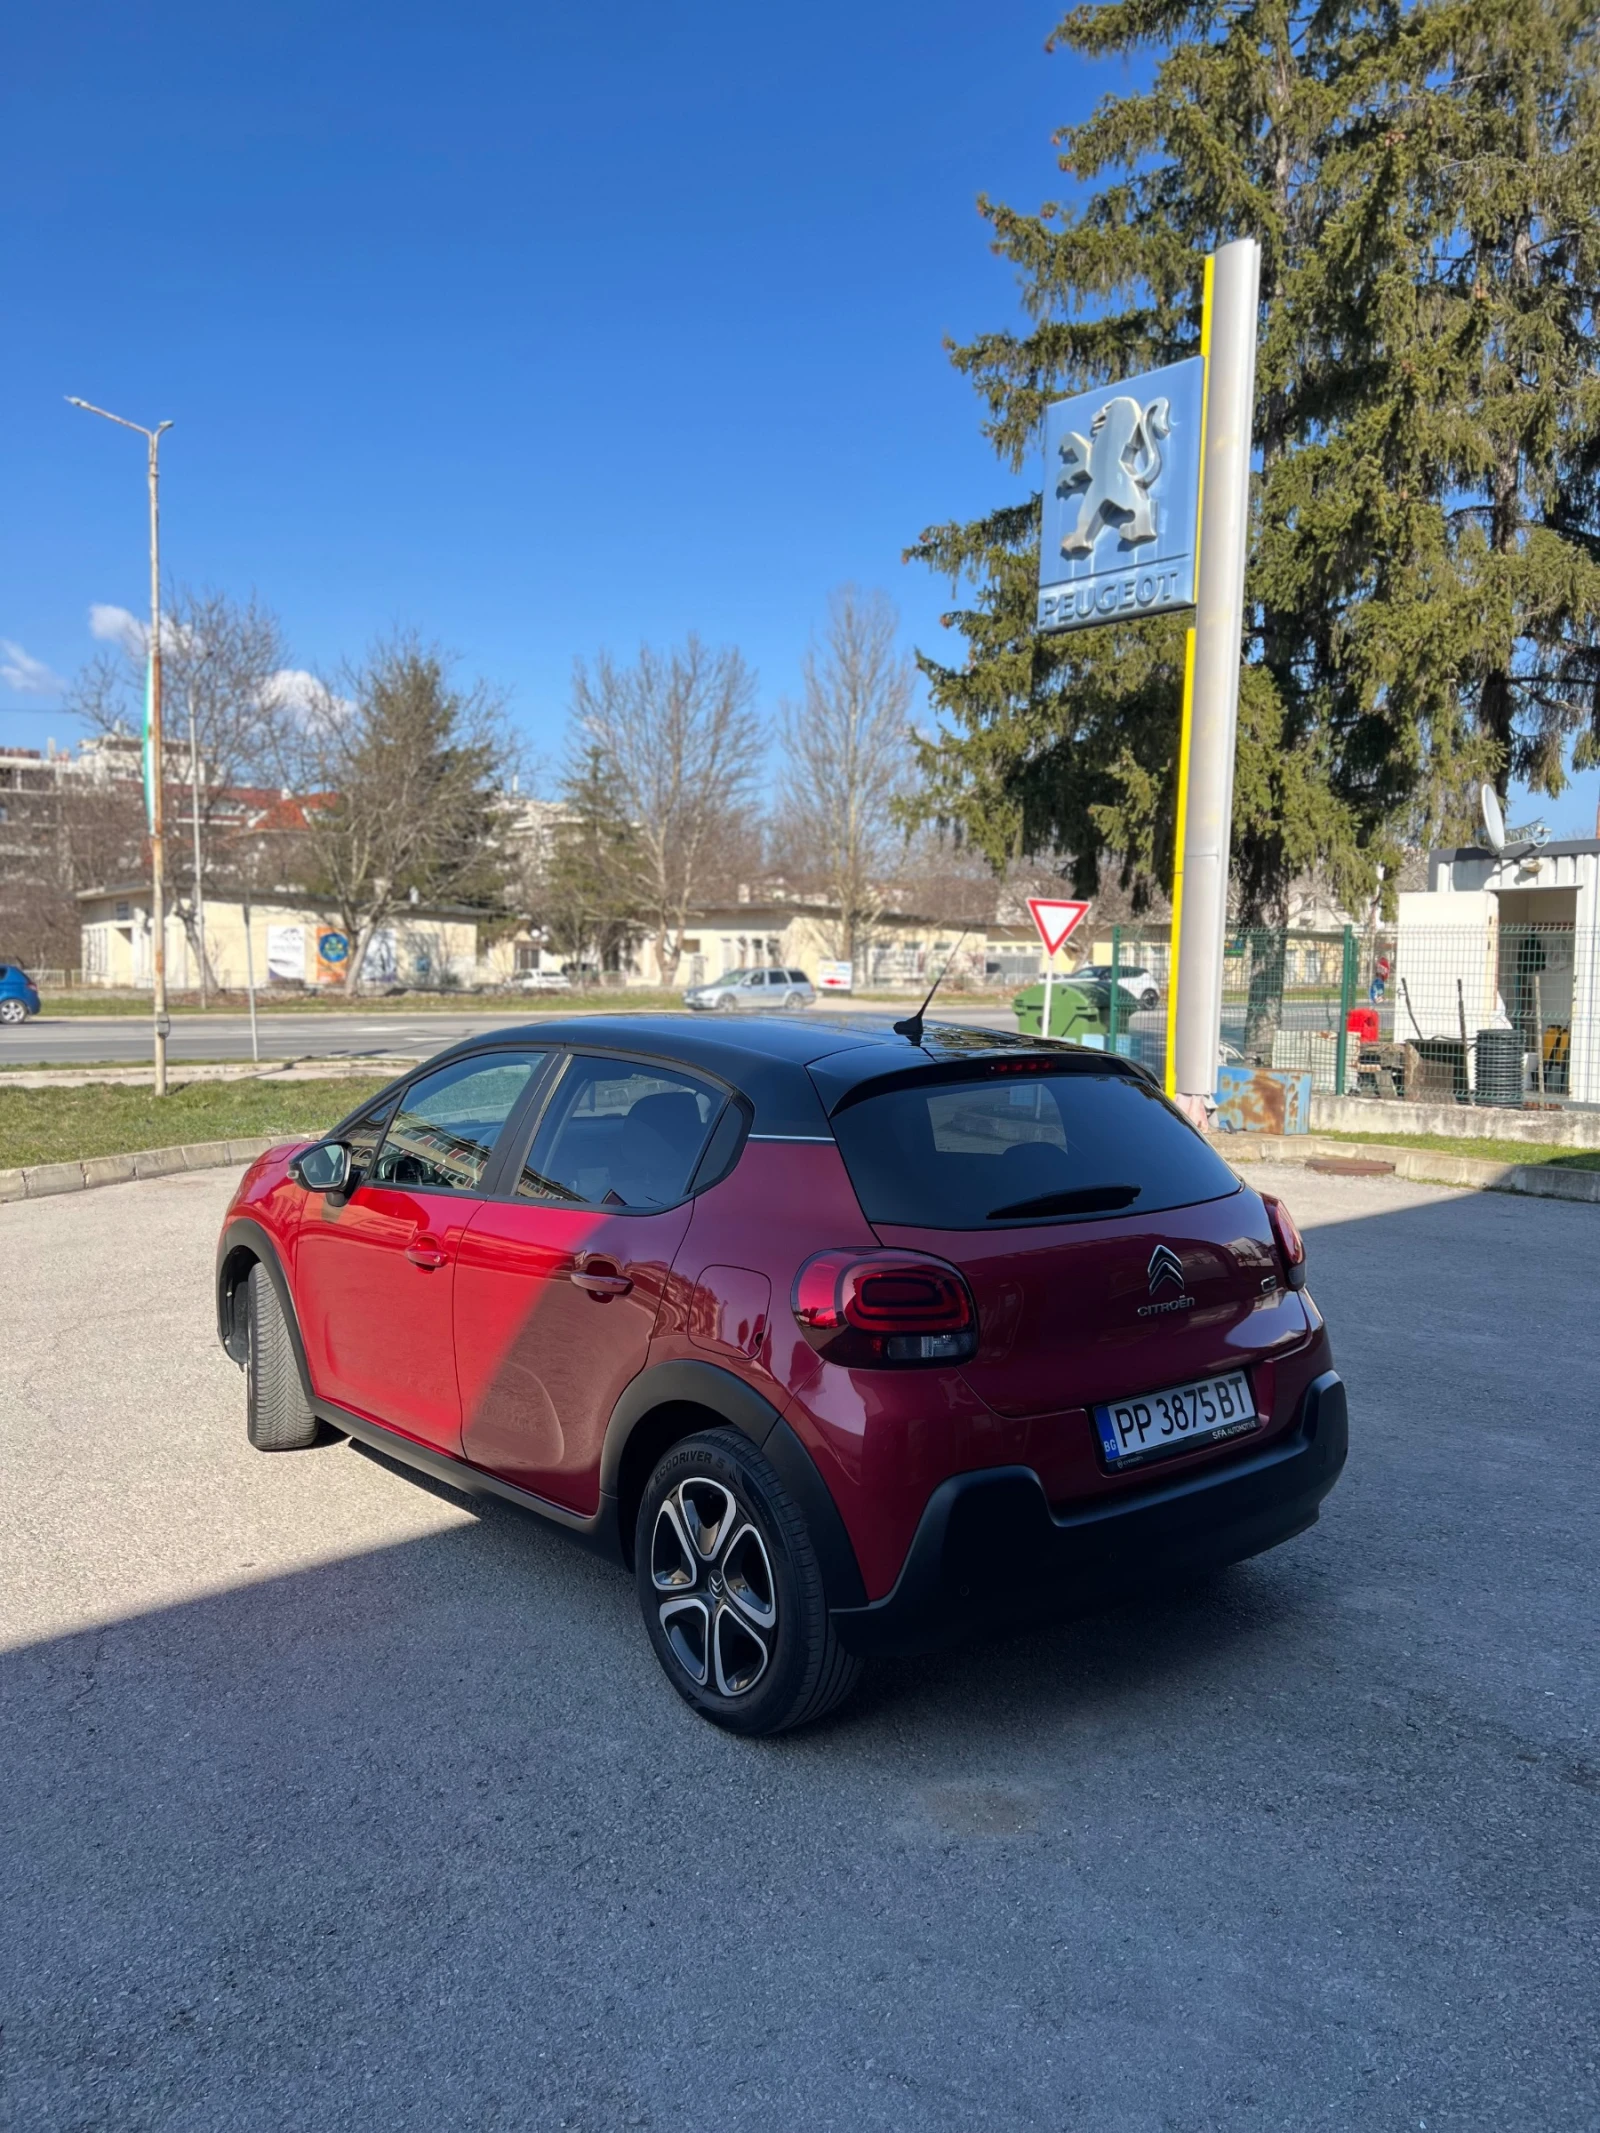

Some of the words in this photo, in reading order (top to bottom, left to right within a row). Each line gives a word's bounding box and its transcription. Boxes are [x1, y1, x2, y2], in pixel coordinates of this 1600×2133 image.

[1038, 571, 1178, 625] PEUGEOT
[1137, 1294, 1195, 1317] CITROËN
[1114, 1402, 1152, 1448] PP
[1156, 1385, 1217, 1436] 3875
[1214, 1376, 1246, 1420] BT
[1103, 1438, 1117, 1453] BG
[1211, 1429, 1227, 1441] SFA
[654, 1450, 713, 1484] ECODRIVER
